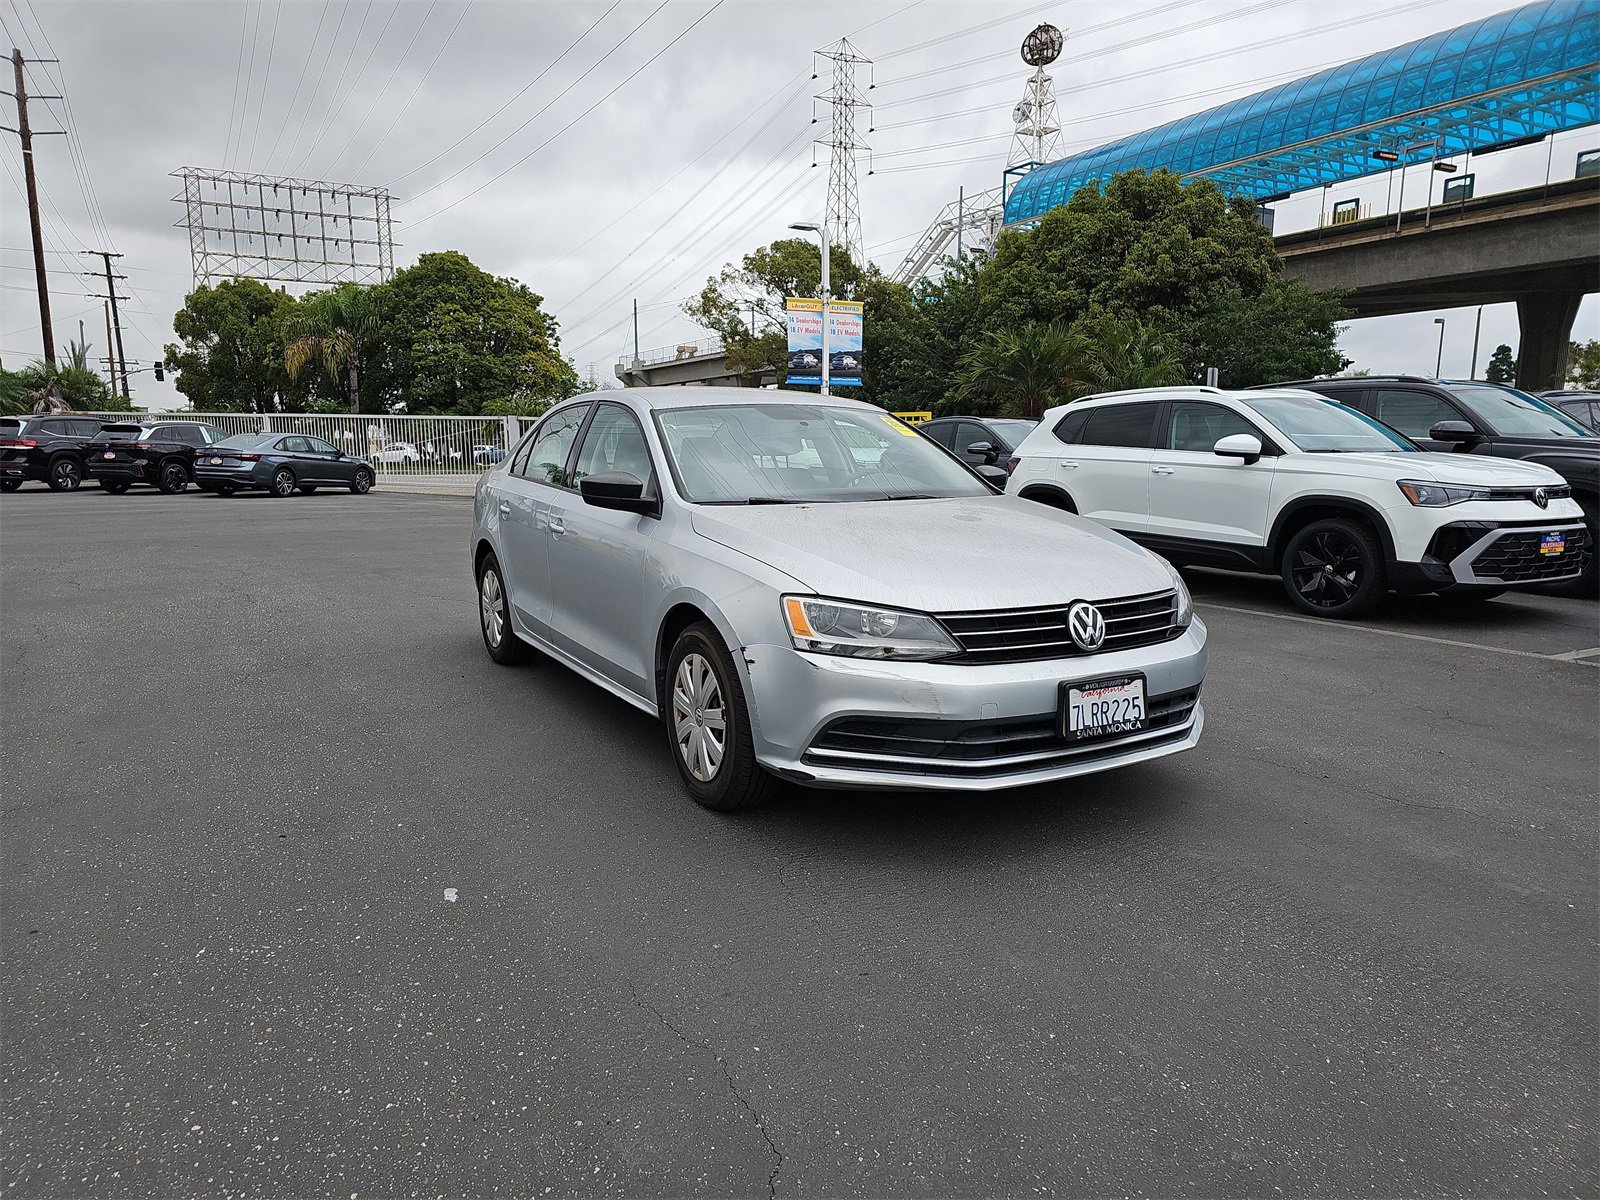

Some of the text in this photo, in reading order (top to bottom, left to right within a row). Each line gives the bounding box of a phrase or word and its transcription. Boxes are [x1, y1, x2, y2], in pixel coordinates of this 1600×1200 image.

[796, 317, 821, 326] Dealerships
[829, 318, 861, 328] 14 Dealerships
[1081, 684, 1130, 699] California
[1072, 696, 1141, 731] 7LRR225
[1077, 721, 1142, 739] SANTA MONICA
